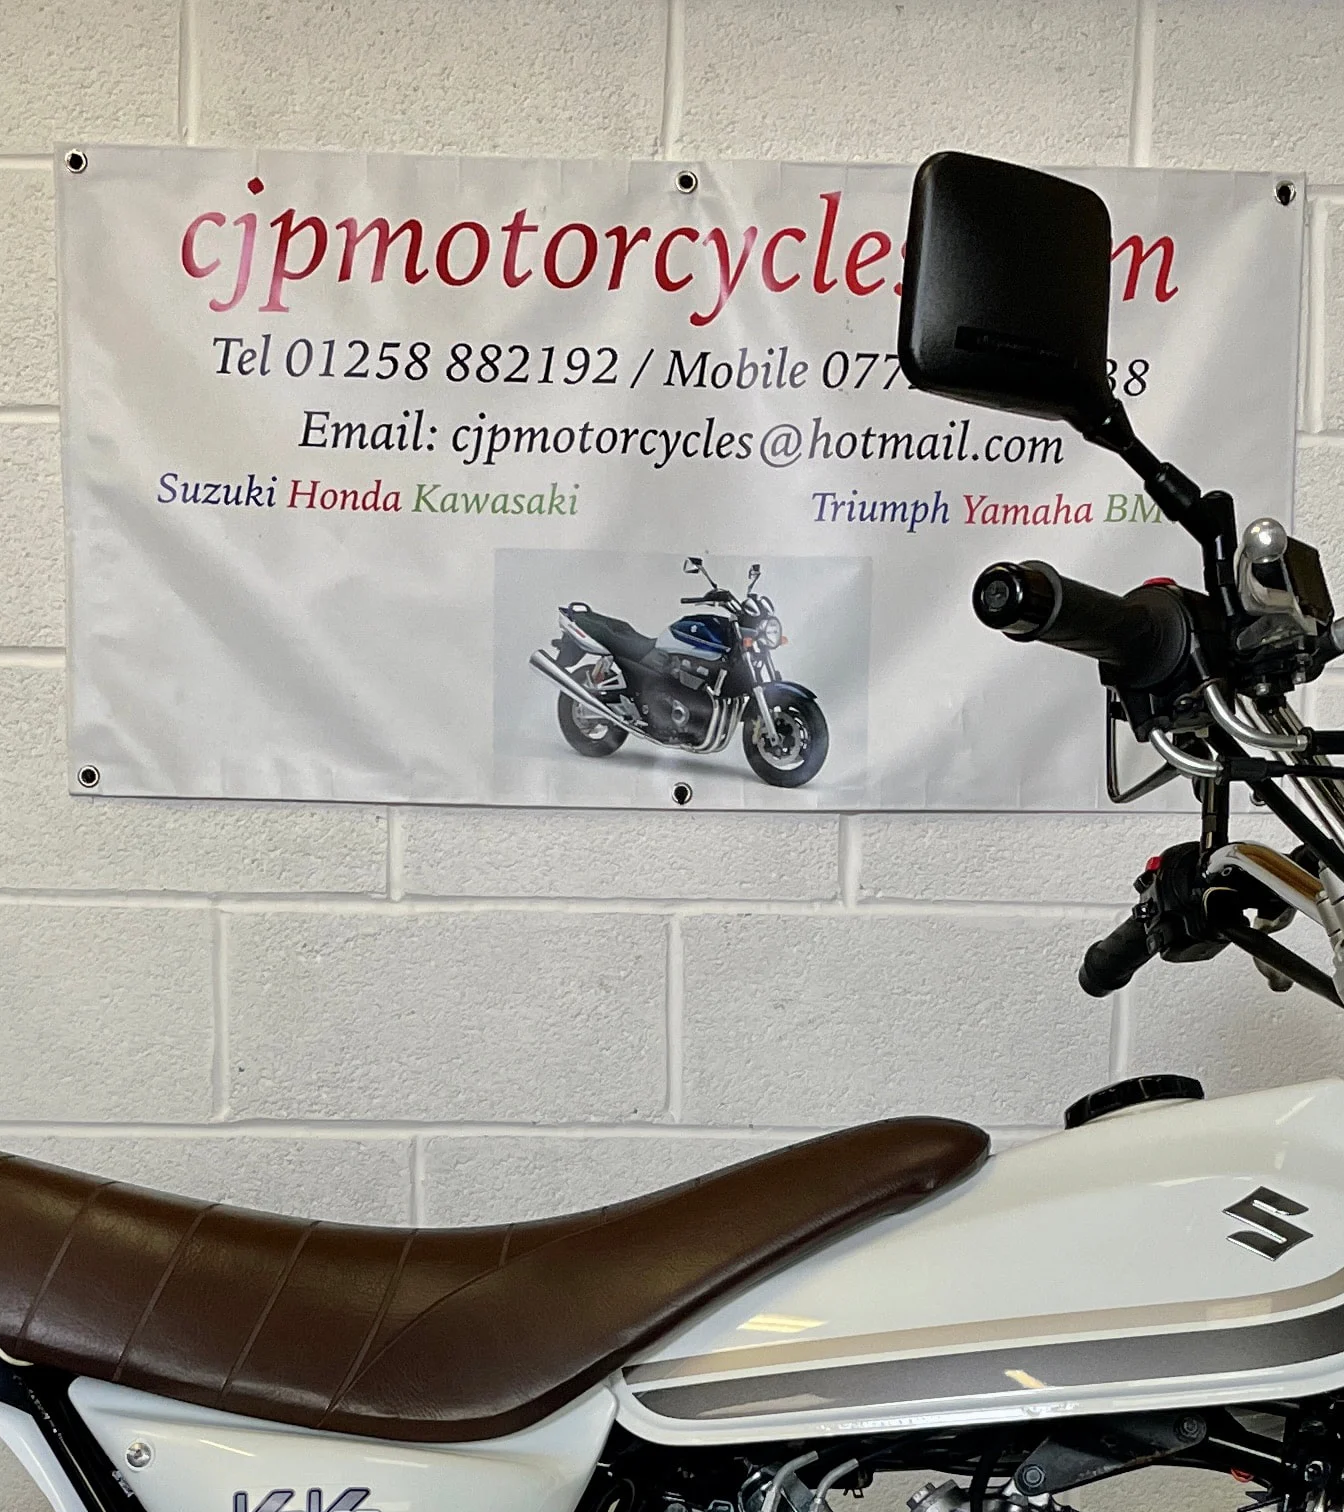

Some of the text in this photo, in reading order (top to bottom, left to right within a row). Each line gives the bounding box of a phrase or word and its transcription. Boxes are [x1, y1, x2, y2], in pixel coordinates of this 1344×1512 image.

[180, 176, 1180, 328] cjpmotorcyclem
[212, 335, 946, 391] Tel 01258 882192 / Mobile 077
[298, 410, 1065, 470] Email: cjpmotorcycles@hotmail.com
[157, 473, 580, 517] Suzuki Honda Kawasaki
[811, 491, 1178, 536] Triumph Yamaha BM
